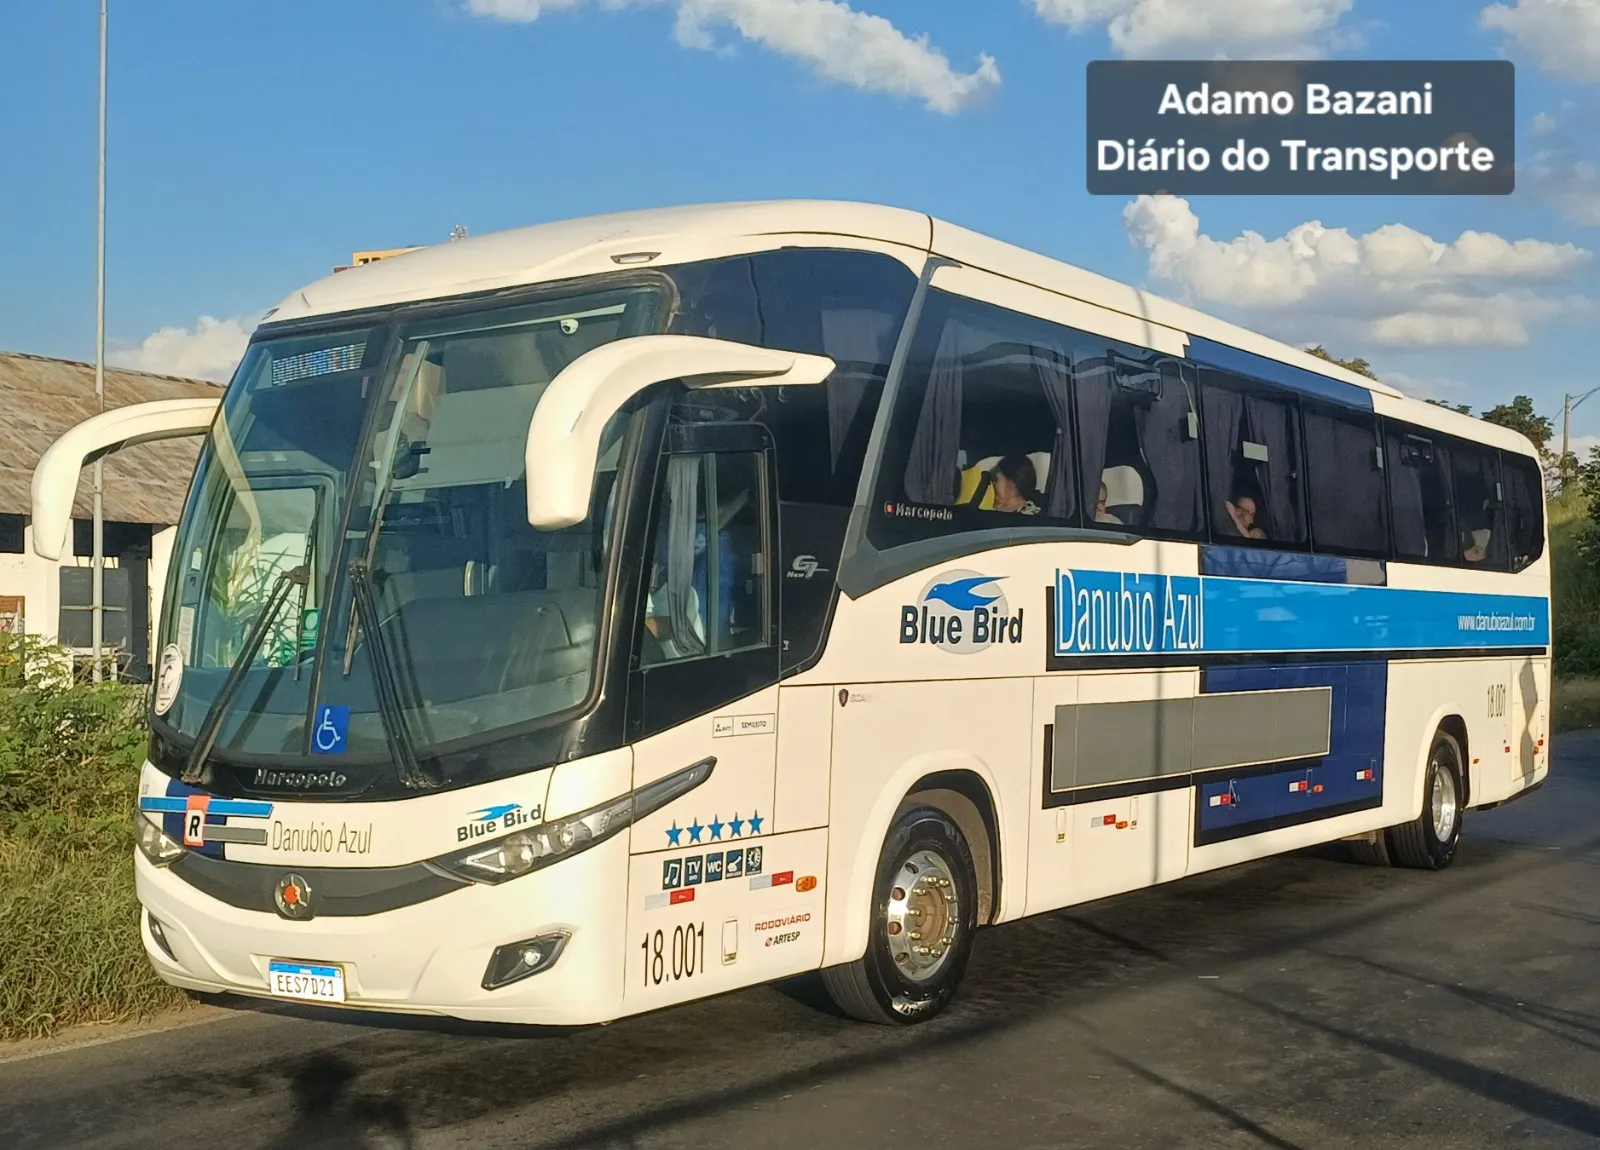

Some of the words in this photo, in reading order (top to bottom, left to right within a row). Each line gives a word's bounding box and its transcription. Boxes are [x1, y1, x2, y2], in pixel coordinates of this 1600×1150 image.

[895, 502, 953, 521] Marcopolo
[1059, 569, 1156, 651] Danubio
[1161, 574, 1205, 650] Azul
[1457, 610, 1536, 632] www.danubioazul.com.br
[899, 604, 963, 645] Blue
[972, 605, 1024, 644] Bird
[254, 768, 347, 789] Marcopolo
[189, 815, 201, 837] R
[457, 819, 498, 843] Blue
[503, 803, 542, 829] Bird
[272, 820, 334, 854] Danubio
[336, 821, 373, 855] Azul
[686, 860, 701, 875] TV
[707, 859, 722, 874] WC
[754, 912, 811, 932] RODOVIÁRIO
[772, 930, 801, 947] ARTESP
[641, 920, 705, 988] 18.001
[276, 974, 335, 997] EES7D21
